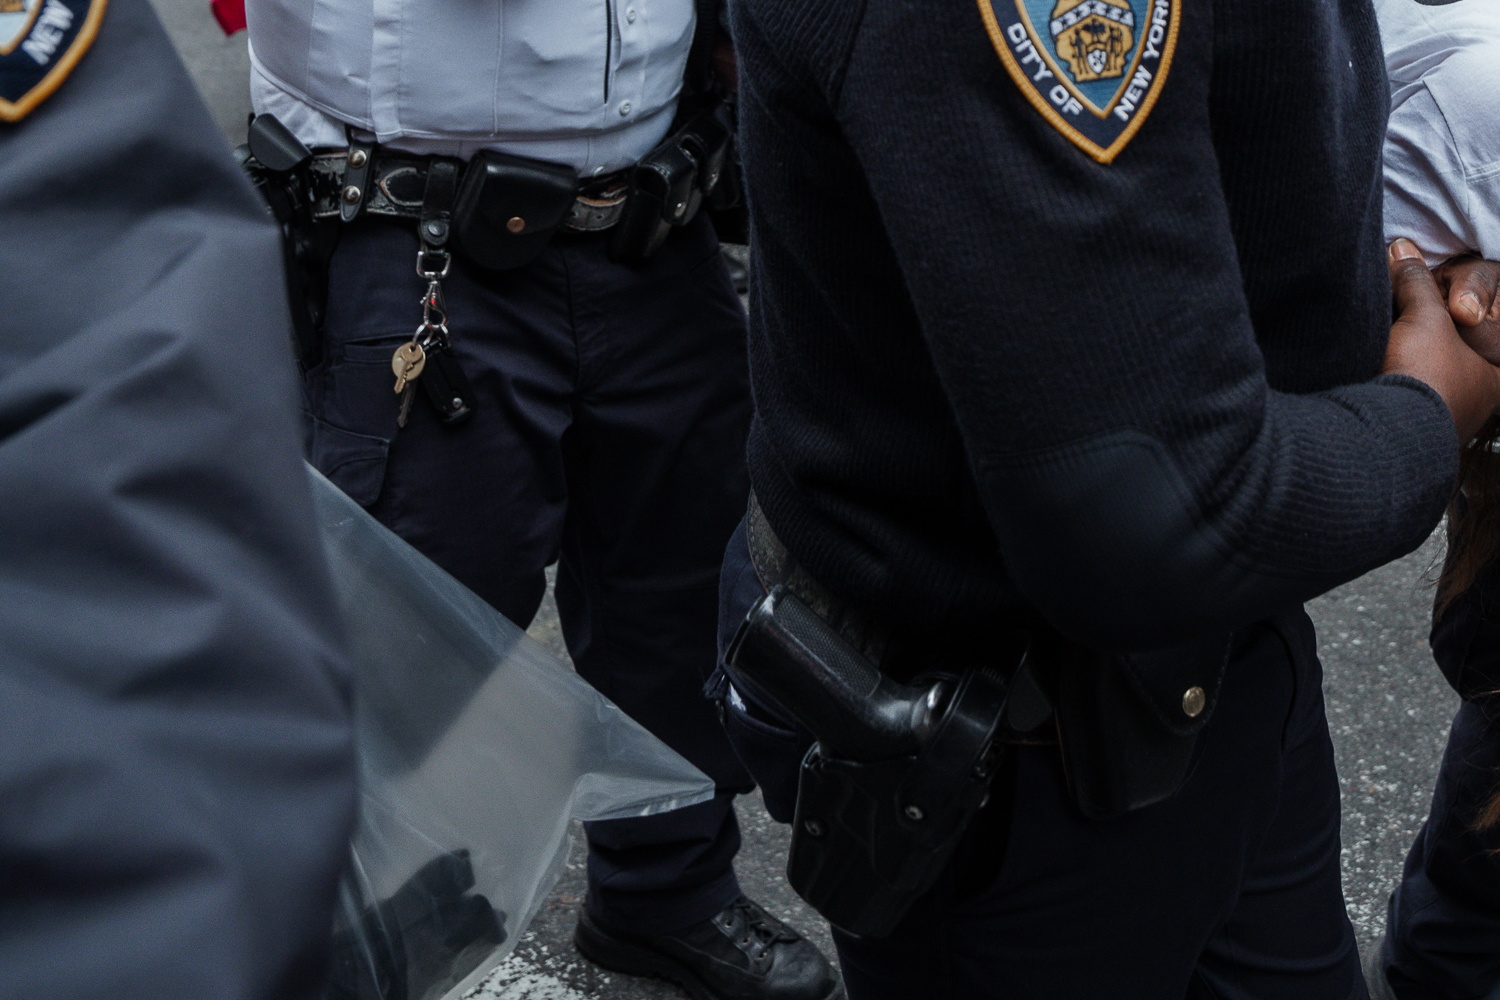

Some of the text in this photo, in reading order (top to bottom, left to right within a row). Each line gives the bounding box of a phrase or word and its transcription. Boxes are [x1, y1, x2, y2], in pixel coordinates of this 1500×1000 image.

[1007, 22, 1084, 116] CITY OF
[1113, 64, 1153, 122] NEW
